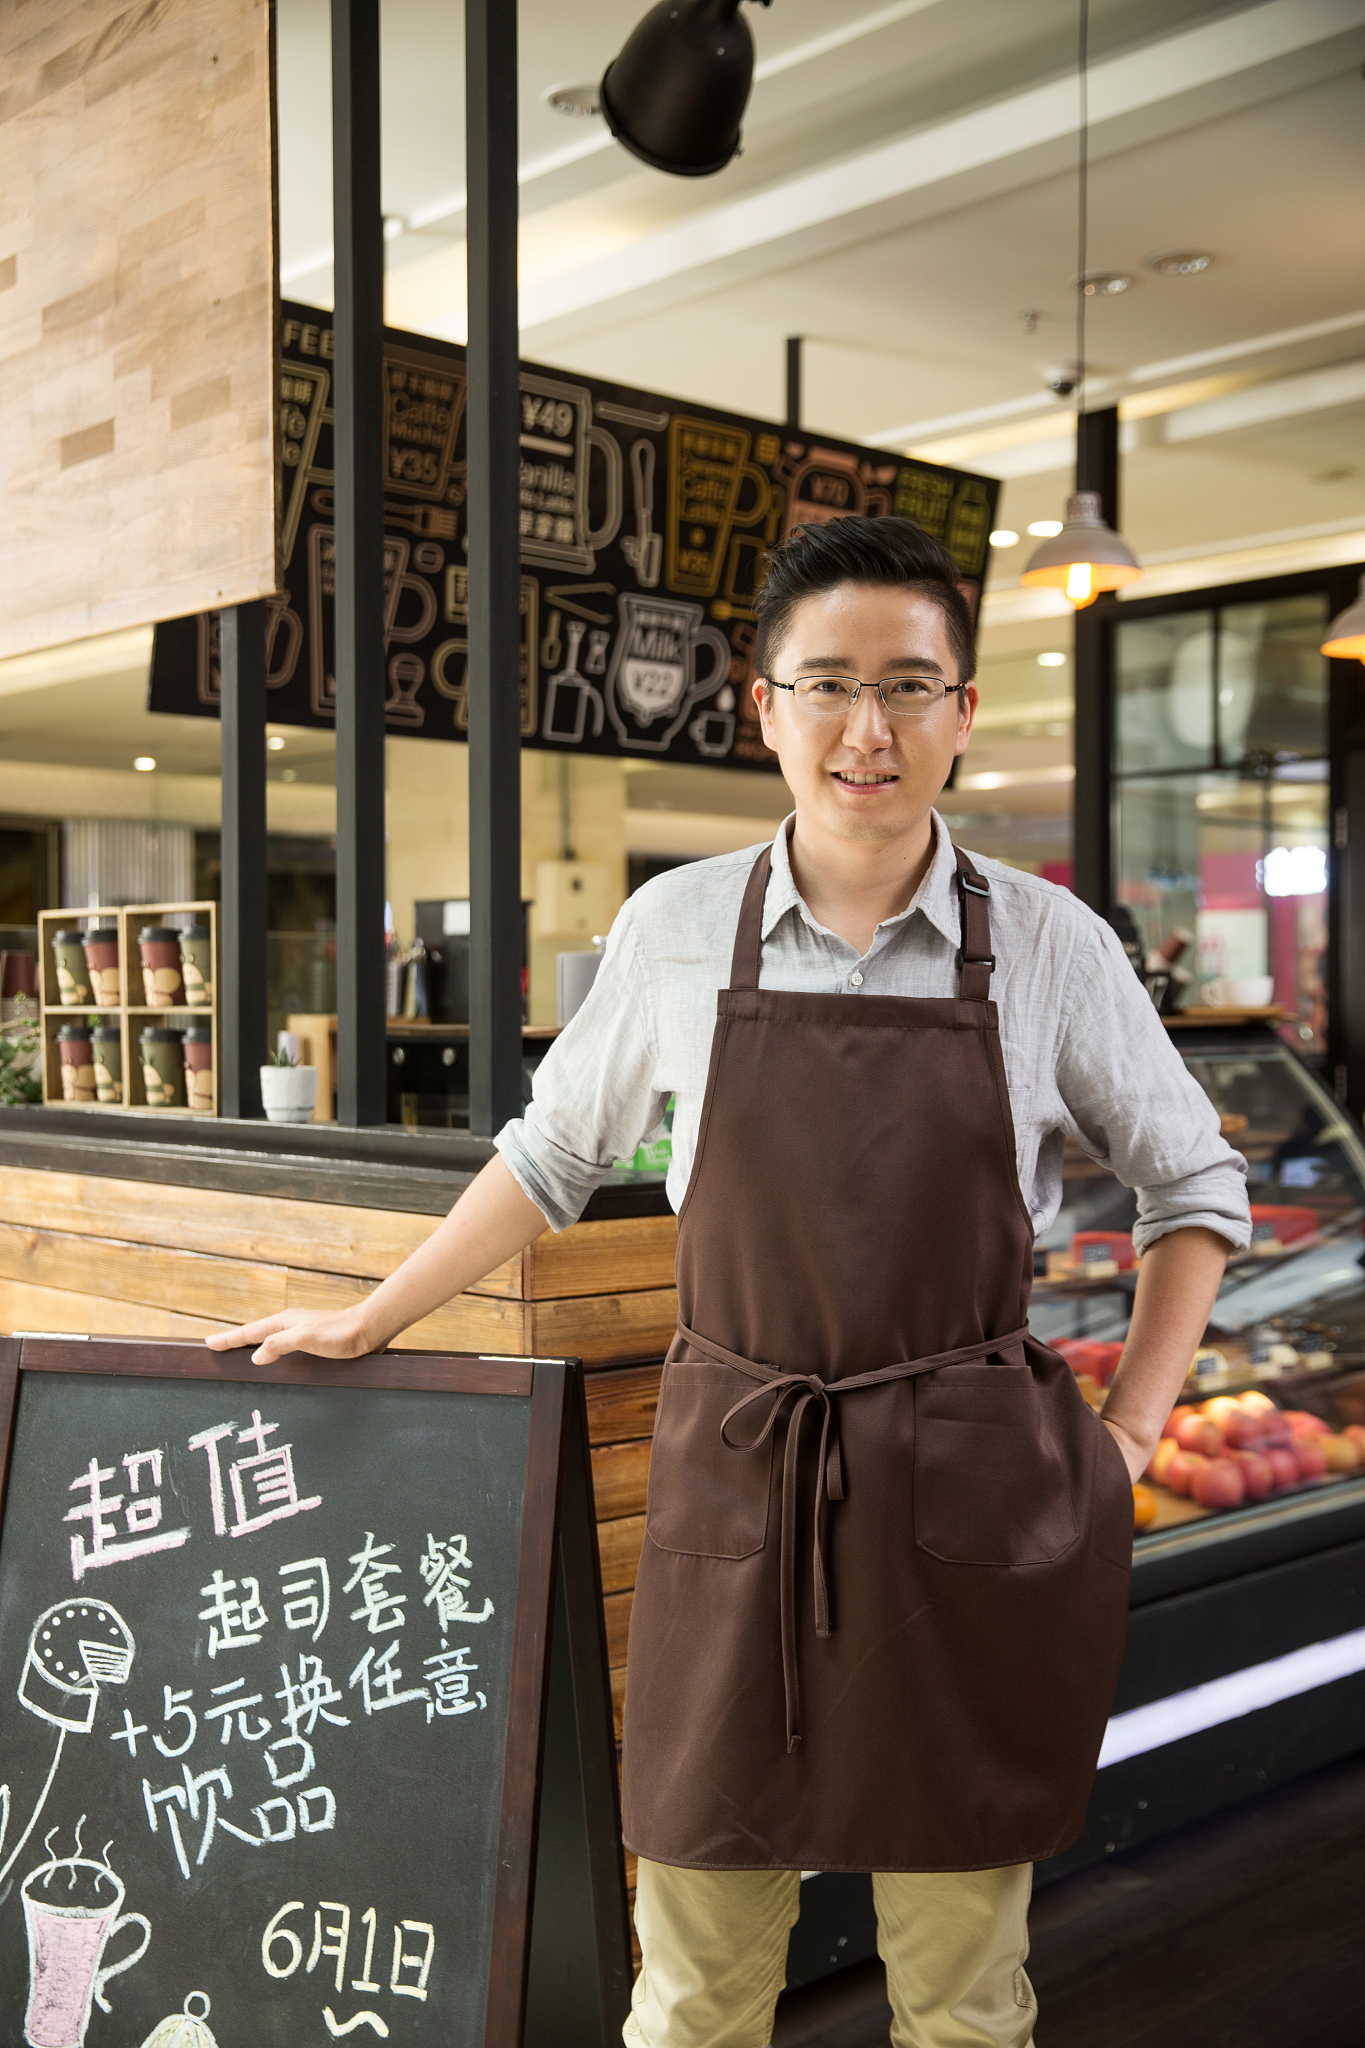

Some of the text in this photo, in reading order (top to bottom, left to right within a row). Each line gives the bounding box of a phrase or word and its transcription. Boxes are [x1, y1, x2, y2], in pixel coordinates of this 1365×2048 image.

[522, 393, 574, 438] ¥49
[519, 456, 576, 496] anilla
[632, 628, 684, 662] Milk
[62, 1409, 323, 1583] 超值
[198, 1532, 495, 1659] 起司套餐
[142, 1736, 337, 1880] 饮品
[262, 1901, 435, 2002] 6月1日
